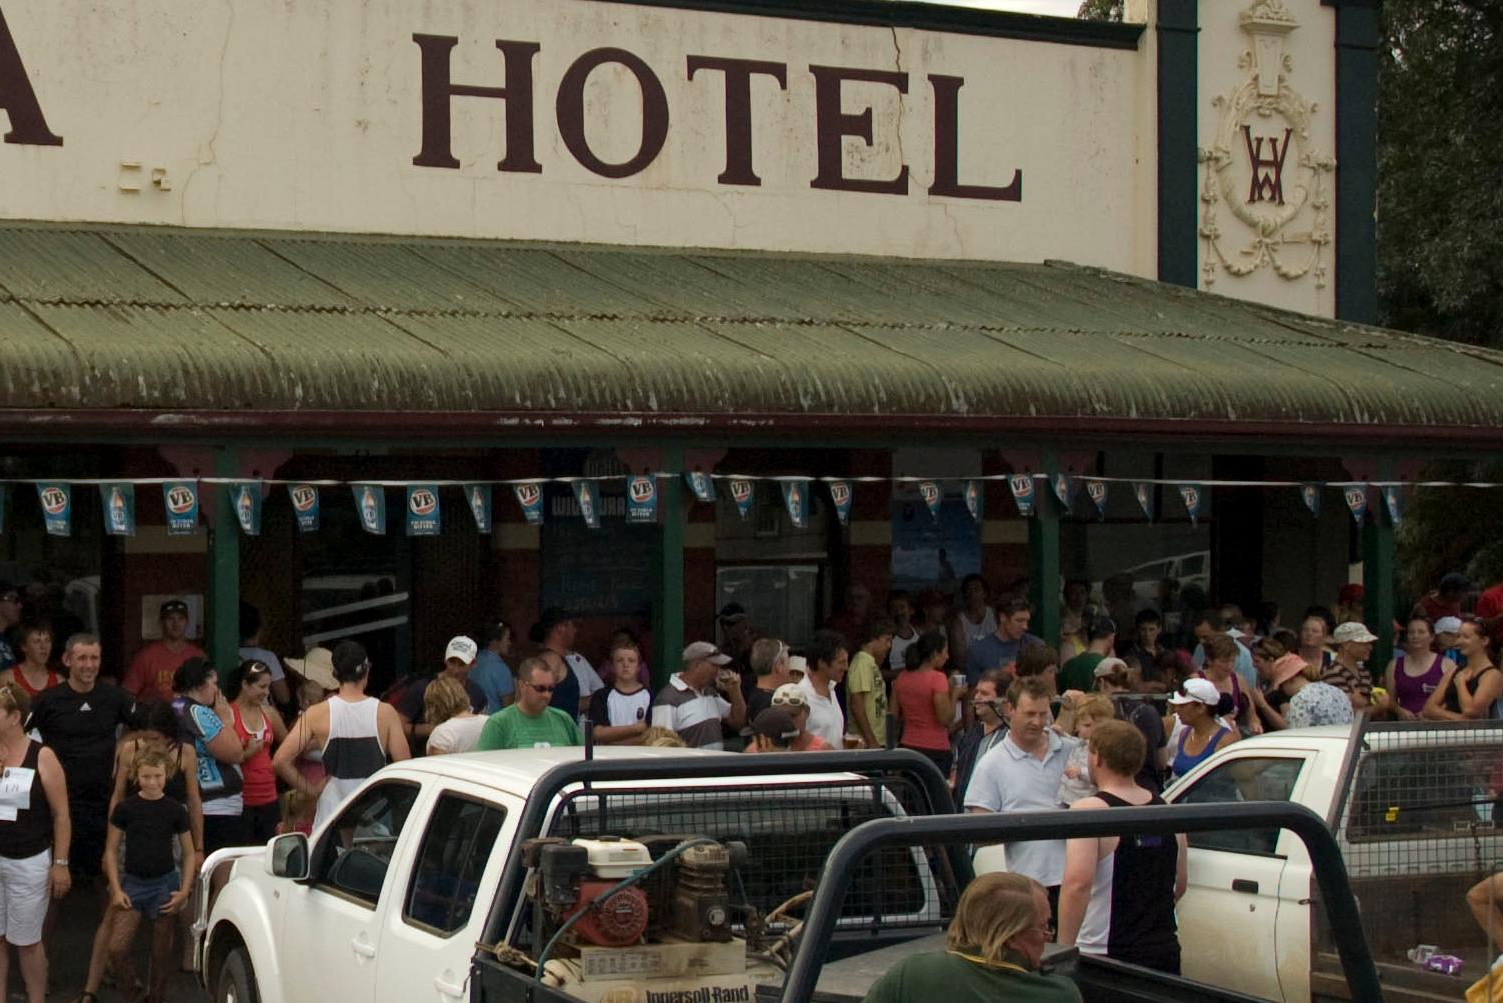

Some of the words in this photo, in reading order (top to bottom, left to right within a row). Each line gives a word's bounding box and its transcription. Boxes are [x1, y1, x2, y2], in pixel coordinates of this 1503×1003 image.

[412, 33, 1022, 203] HOTEL
[293, 489, 315, 503] VB
[519, 485, 540, 500] VB
[633, 481, 652, 496] VB
[733, 483, 751, 498] VB
[43, 490, 65, 506] VB
[169, 490, 192, 505] VB
[414, 493, 434, 508] VB
